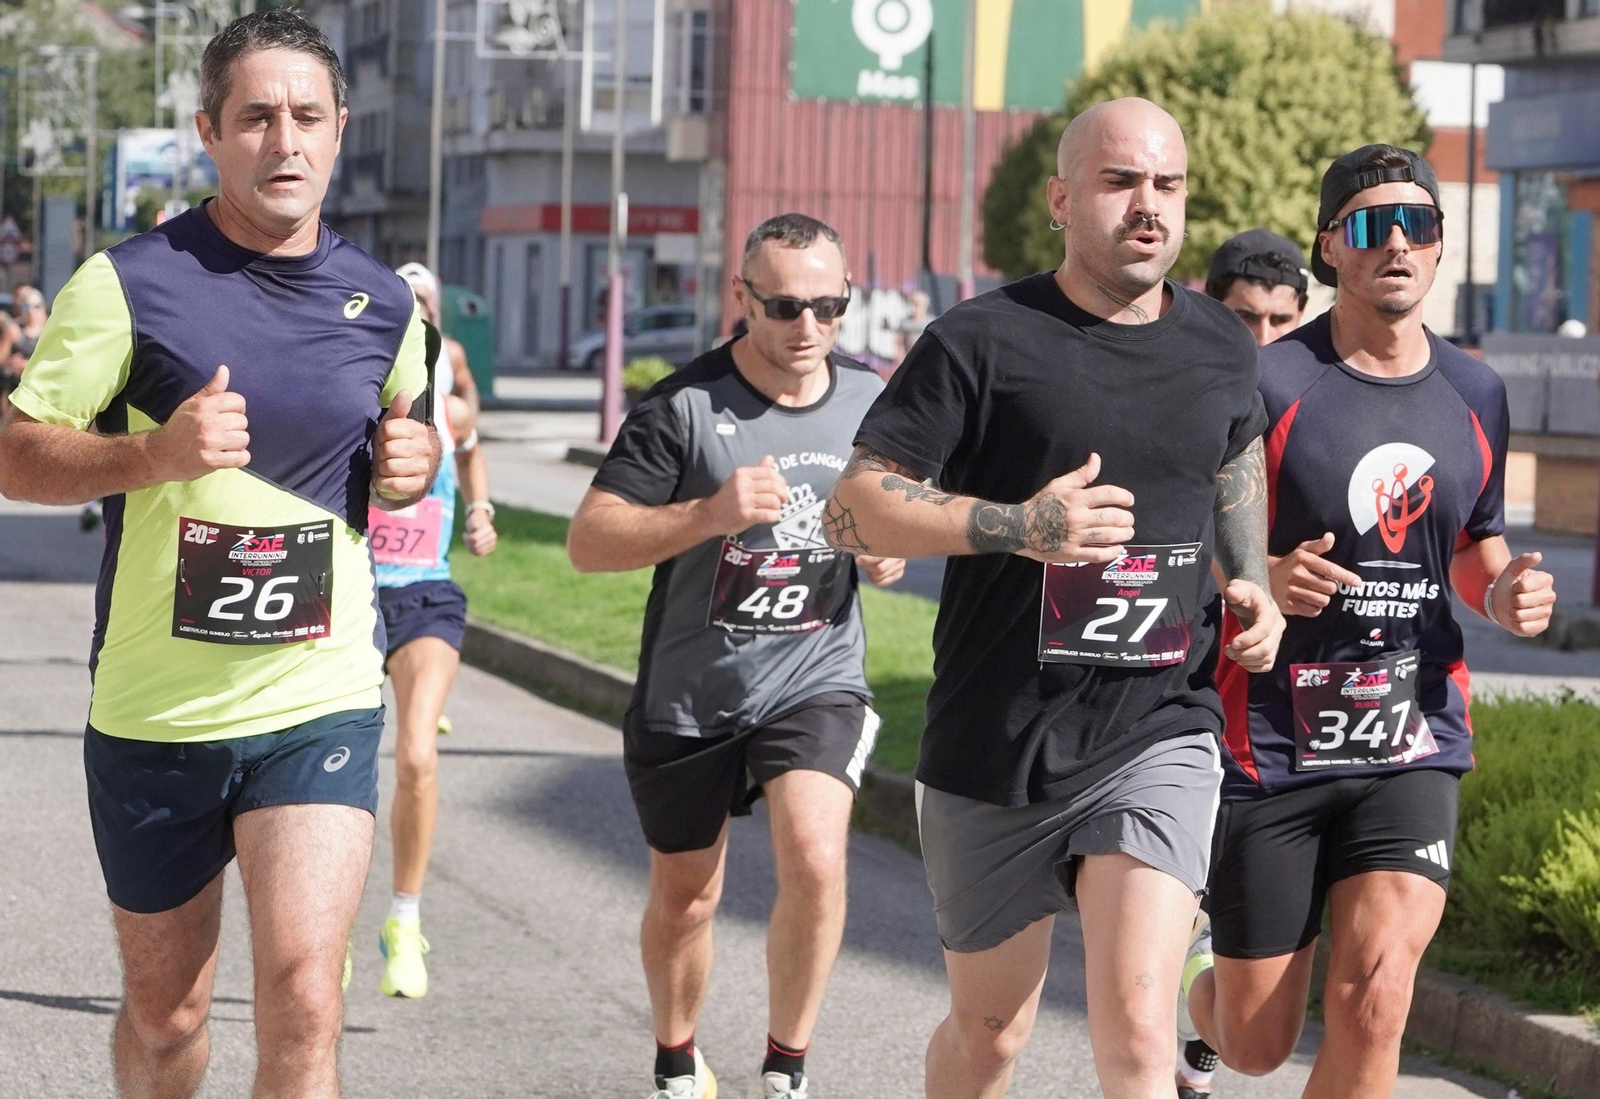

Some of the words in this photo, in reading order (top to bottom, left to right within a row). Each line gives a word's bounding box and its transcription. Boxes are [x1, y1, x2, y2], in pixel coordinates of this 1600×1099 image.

[779, 453, 799, 470] DE
[184, 522, 208, 545] 20
[208, 527, 220, 535] SEP
[245, 534, 285, 552] CAE
[370, 525, 426, 554] 637
[724, 547, 743, 566] 20
[1117, 555, 1157, 573] CAE
[242, 568, 272, 576] VICTOR
[207, 576, 300, 622] 26
[1117, 588, 1141, 598] Angel
[1338, 581, 1401, 598] UNTOS
[1401, 578, 1440, 600] MÁS
[737, 585, 810, 619] 48
[1341, 598, 1420, 619] FUERTES
[1080, 597, 1169, 643] 27
[1353, 671, 1388, 688] CAE
[1317, 699, 1411, 751] 347
